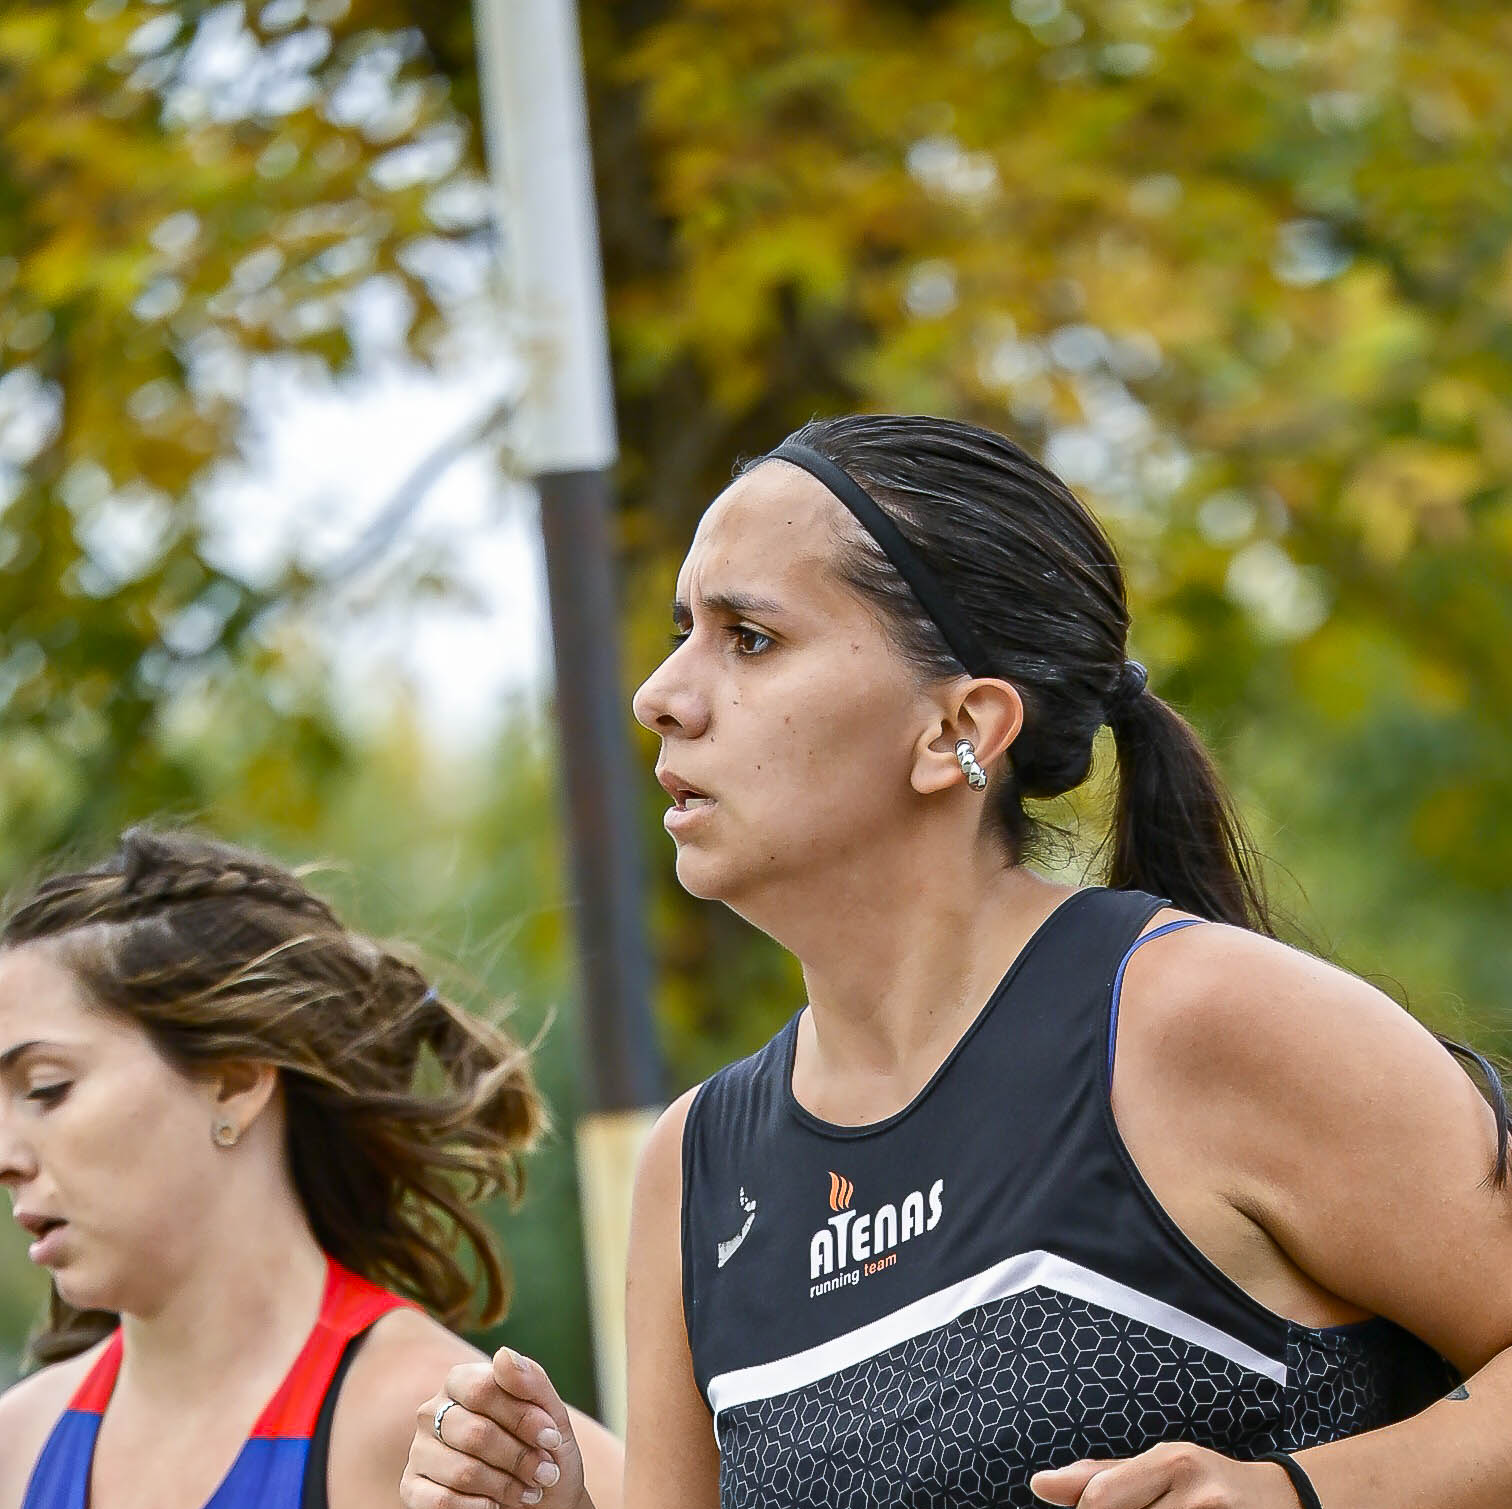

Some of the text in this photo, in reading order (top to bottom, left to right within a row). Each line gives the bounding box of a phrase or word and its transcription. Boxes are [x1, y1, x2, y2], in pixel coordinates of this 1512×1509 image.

[810, 1178, 944, 1280] ATENAS
[809, 1253, 897, 1299] running team
